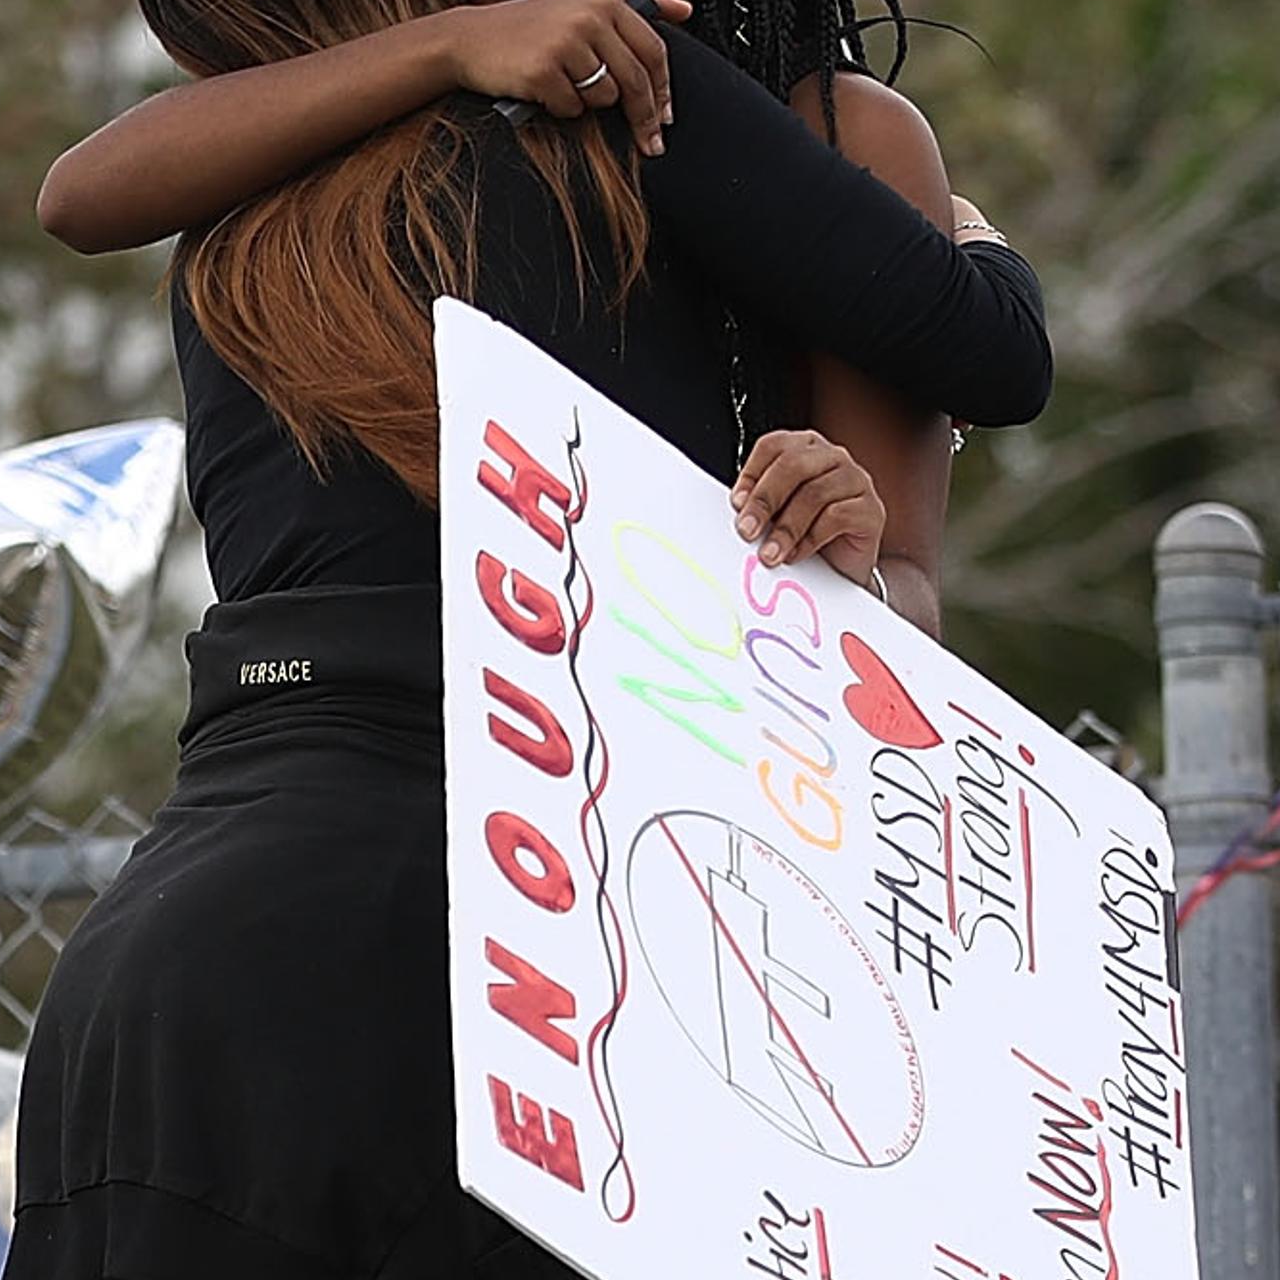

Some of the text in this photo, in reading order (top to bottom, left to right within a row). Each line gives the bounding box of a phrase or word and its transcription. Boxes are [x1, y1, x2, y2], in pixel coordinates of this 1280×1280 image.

[239, 659, 312, 685] VERSACE
[607, 520, 746, 767] NO
[475, 419, 585, 1192] ENOUGH
[864, 746, 953, 1011] #MSD
